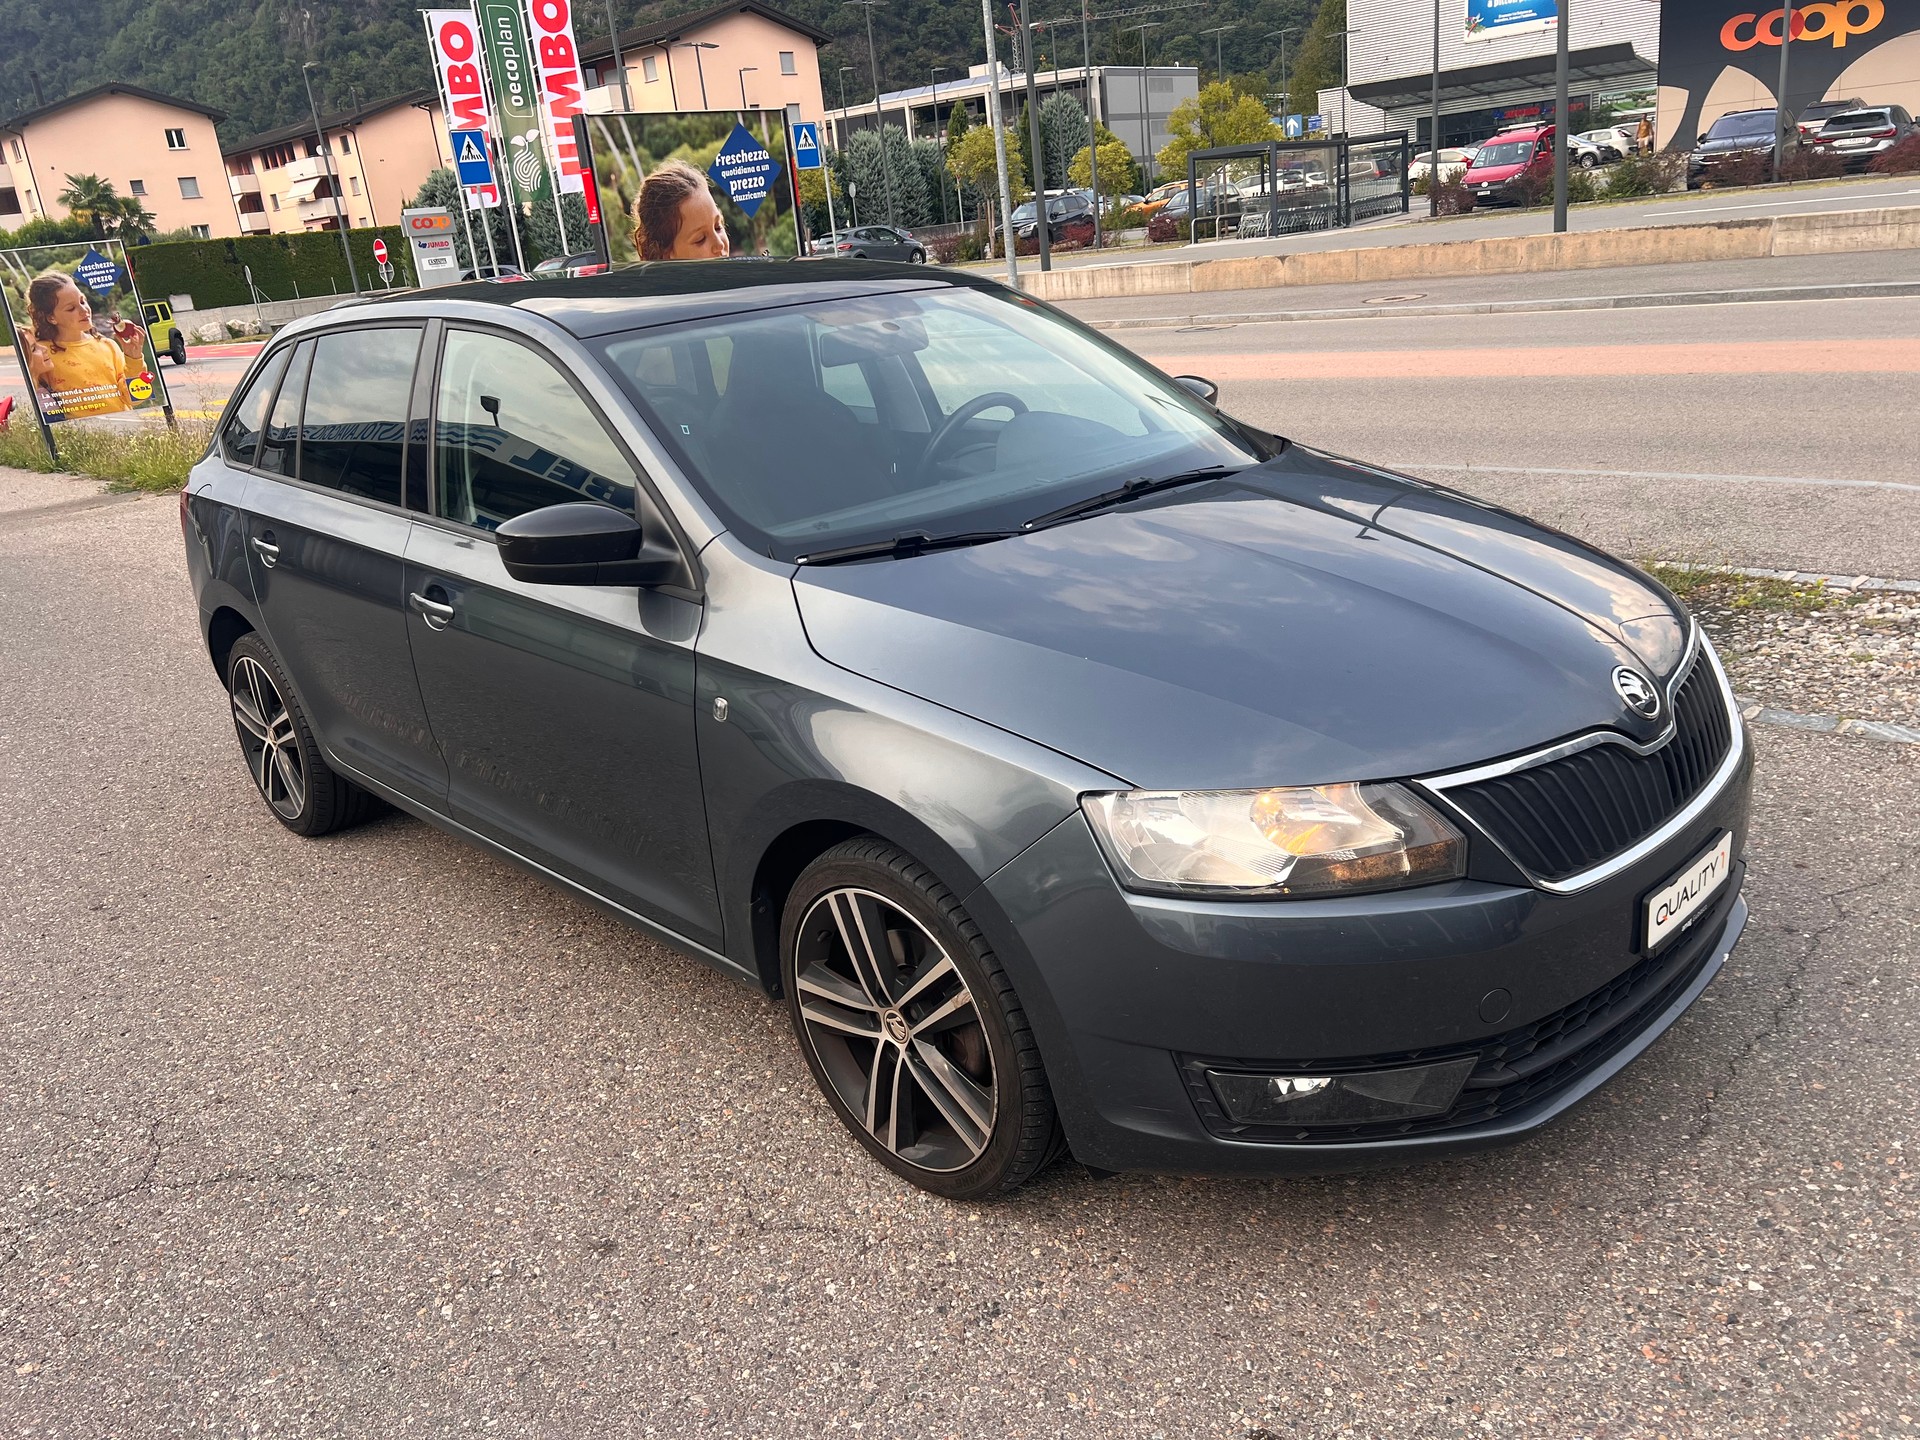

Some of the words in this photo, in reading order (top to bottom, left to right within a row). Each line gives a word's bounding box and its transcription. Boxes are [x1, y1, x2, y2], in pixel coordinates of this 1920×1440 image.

[1720, 0, 1885, 51] coop
[497, 17, 524, 107] oecoplan
[440, 20, 498, 204] JMBO
[715, 149, 770, 167] Freschezza
[721, 165, 756, 179] quotidiana
[761, 163, 770, 171] un
[729, 176, 765, 195] prezzo
[732, 190, 767, 203] stuzzicante
[411, 215, 451, 231] coop
[428, 240, 450, 249] JUMBO
[88, 274, 113, 286] prezzo
[41, 392, 51, 400] La
[51, 388, 83, 398] merenda
[83, 383, 118, 394] mattutina
[44, 401, 57, 409] per
[57, 396, 83, 407] piccoli
[46, 406, 79, 416] conviene
[80, 401, 108, 412] sempre.
